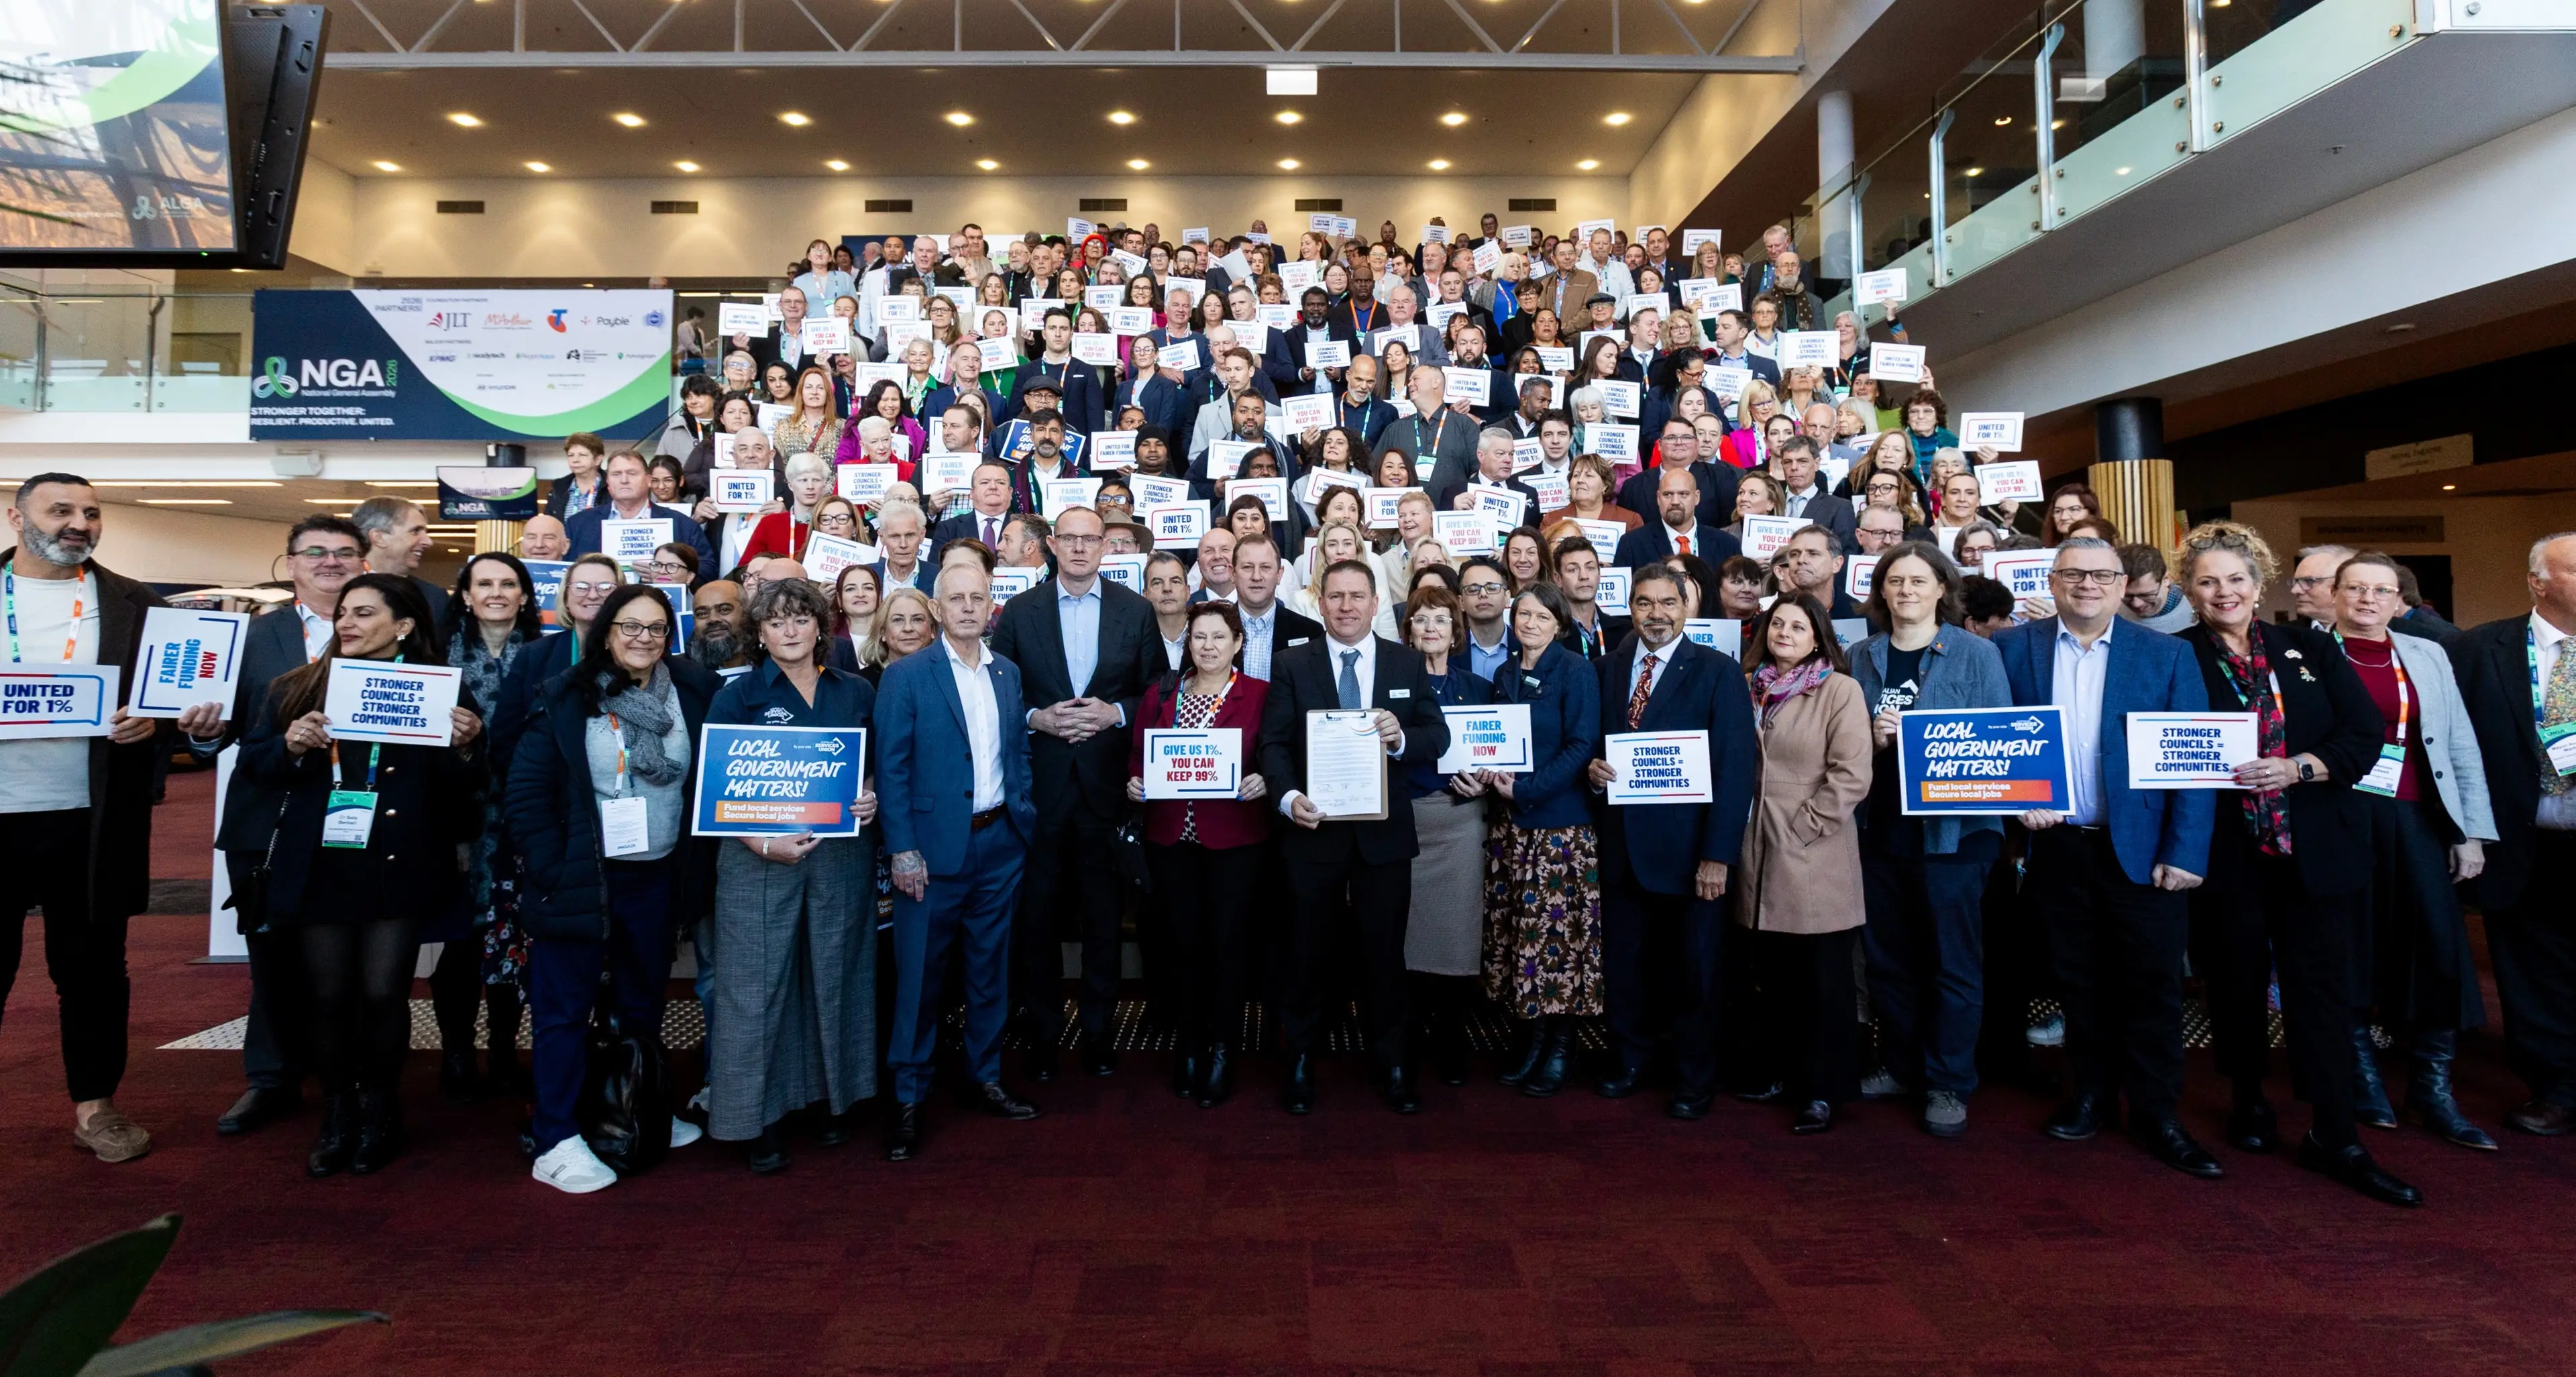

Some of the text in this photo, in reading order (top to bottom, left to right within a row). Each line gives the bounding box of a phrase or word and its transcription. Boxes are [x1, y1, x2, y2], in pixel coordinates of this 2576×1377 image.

[443, 313, 472, 331] JLT
[597, 317, 630, 327] Payble
[301, 359, 385, 387] NGA
[386, 360, 398, 386] 2026
[361, 390, 396, 398] Assembly
[251, 407, 308, 415] STRONGER
[1485, 496, 1509, 508] UNITED
[458, 503, 486, 512] NGA
[1163, 515, 1191, 524] UNITED
[1163, 525, 1192, 533] FOR 1%
[1758, 526, 1774, 534] GIVE
[1758, 543, 1776, 551] KEEP
[2014, 582, 2035, 592] FOR
[159, 643, 181, 684] FAIRER
[178, 639, 201, 689] FUNDING
[199, 651, 217, 678] NOW
[366, 678, 424, 691] STRONGER
[4, 685, 74, 697] UNITED
[361, 690, 415, 702] COUNCILS
[3, 700, 72, 714] FOR 1%
[362, 702, 420, 715] STRONGER
[352, 714, 427, 728] COMMUNITIES
[1466, 720, 1501, 731] FAIRER
[1924, 722, 1977, 739] LOCAL
[2163, 728, 2221, 738] STRONGER
[1462, 733, 1506, 744] FUNDING
[728, 739, 781, 758] LOCAL
[1925, 739, 2049, 758] GOVERNMENT
[2160, 740, 2213, 749] COUNCILS
[1164, 745, 1222, 755] GIVE US 1%.
[1473, 746, 1496, 756] NOW
[1634, 747, 1680, 755] STRONGER
[2163, 751, 2220, 761] STRONGER
[1172, 758, 1214, 768] YOU CAN
[1632, 757, 1675, 767] COUNCILS
[2155, 762, 2229, 772] COMMUNITIES
[726, 759, 847, 778] GOVERNMENT
[1635, 768, 1682, 777] STRONGER
[1926, 759, 2010, 777] MATTERS!
[1167, 771, 1218, 781] KEEP 99%
[724, 779, 808, 798] MATTERS!
[1629, 779, 1689, 788] COMMUNITIES
[1928, 783, 1949, 791] Fund
[724, 804, 747, 812] Fund
[723, 812, 755, 820] Secure
[776, 813, 796, 821] jobs
